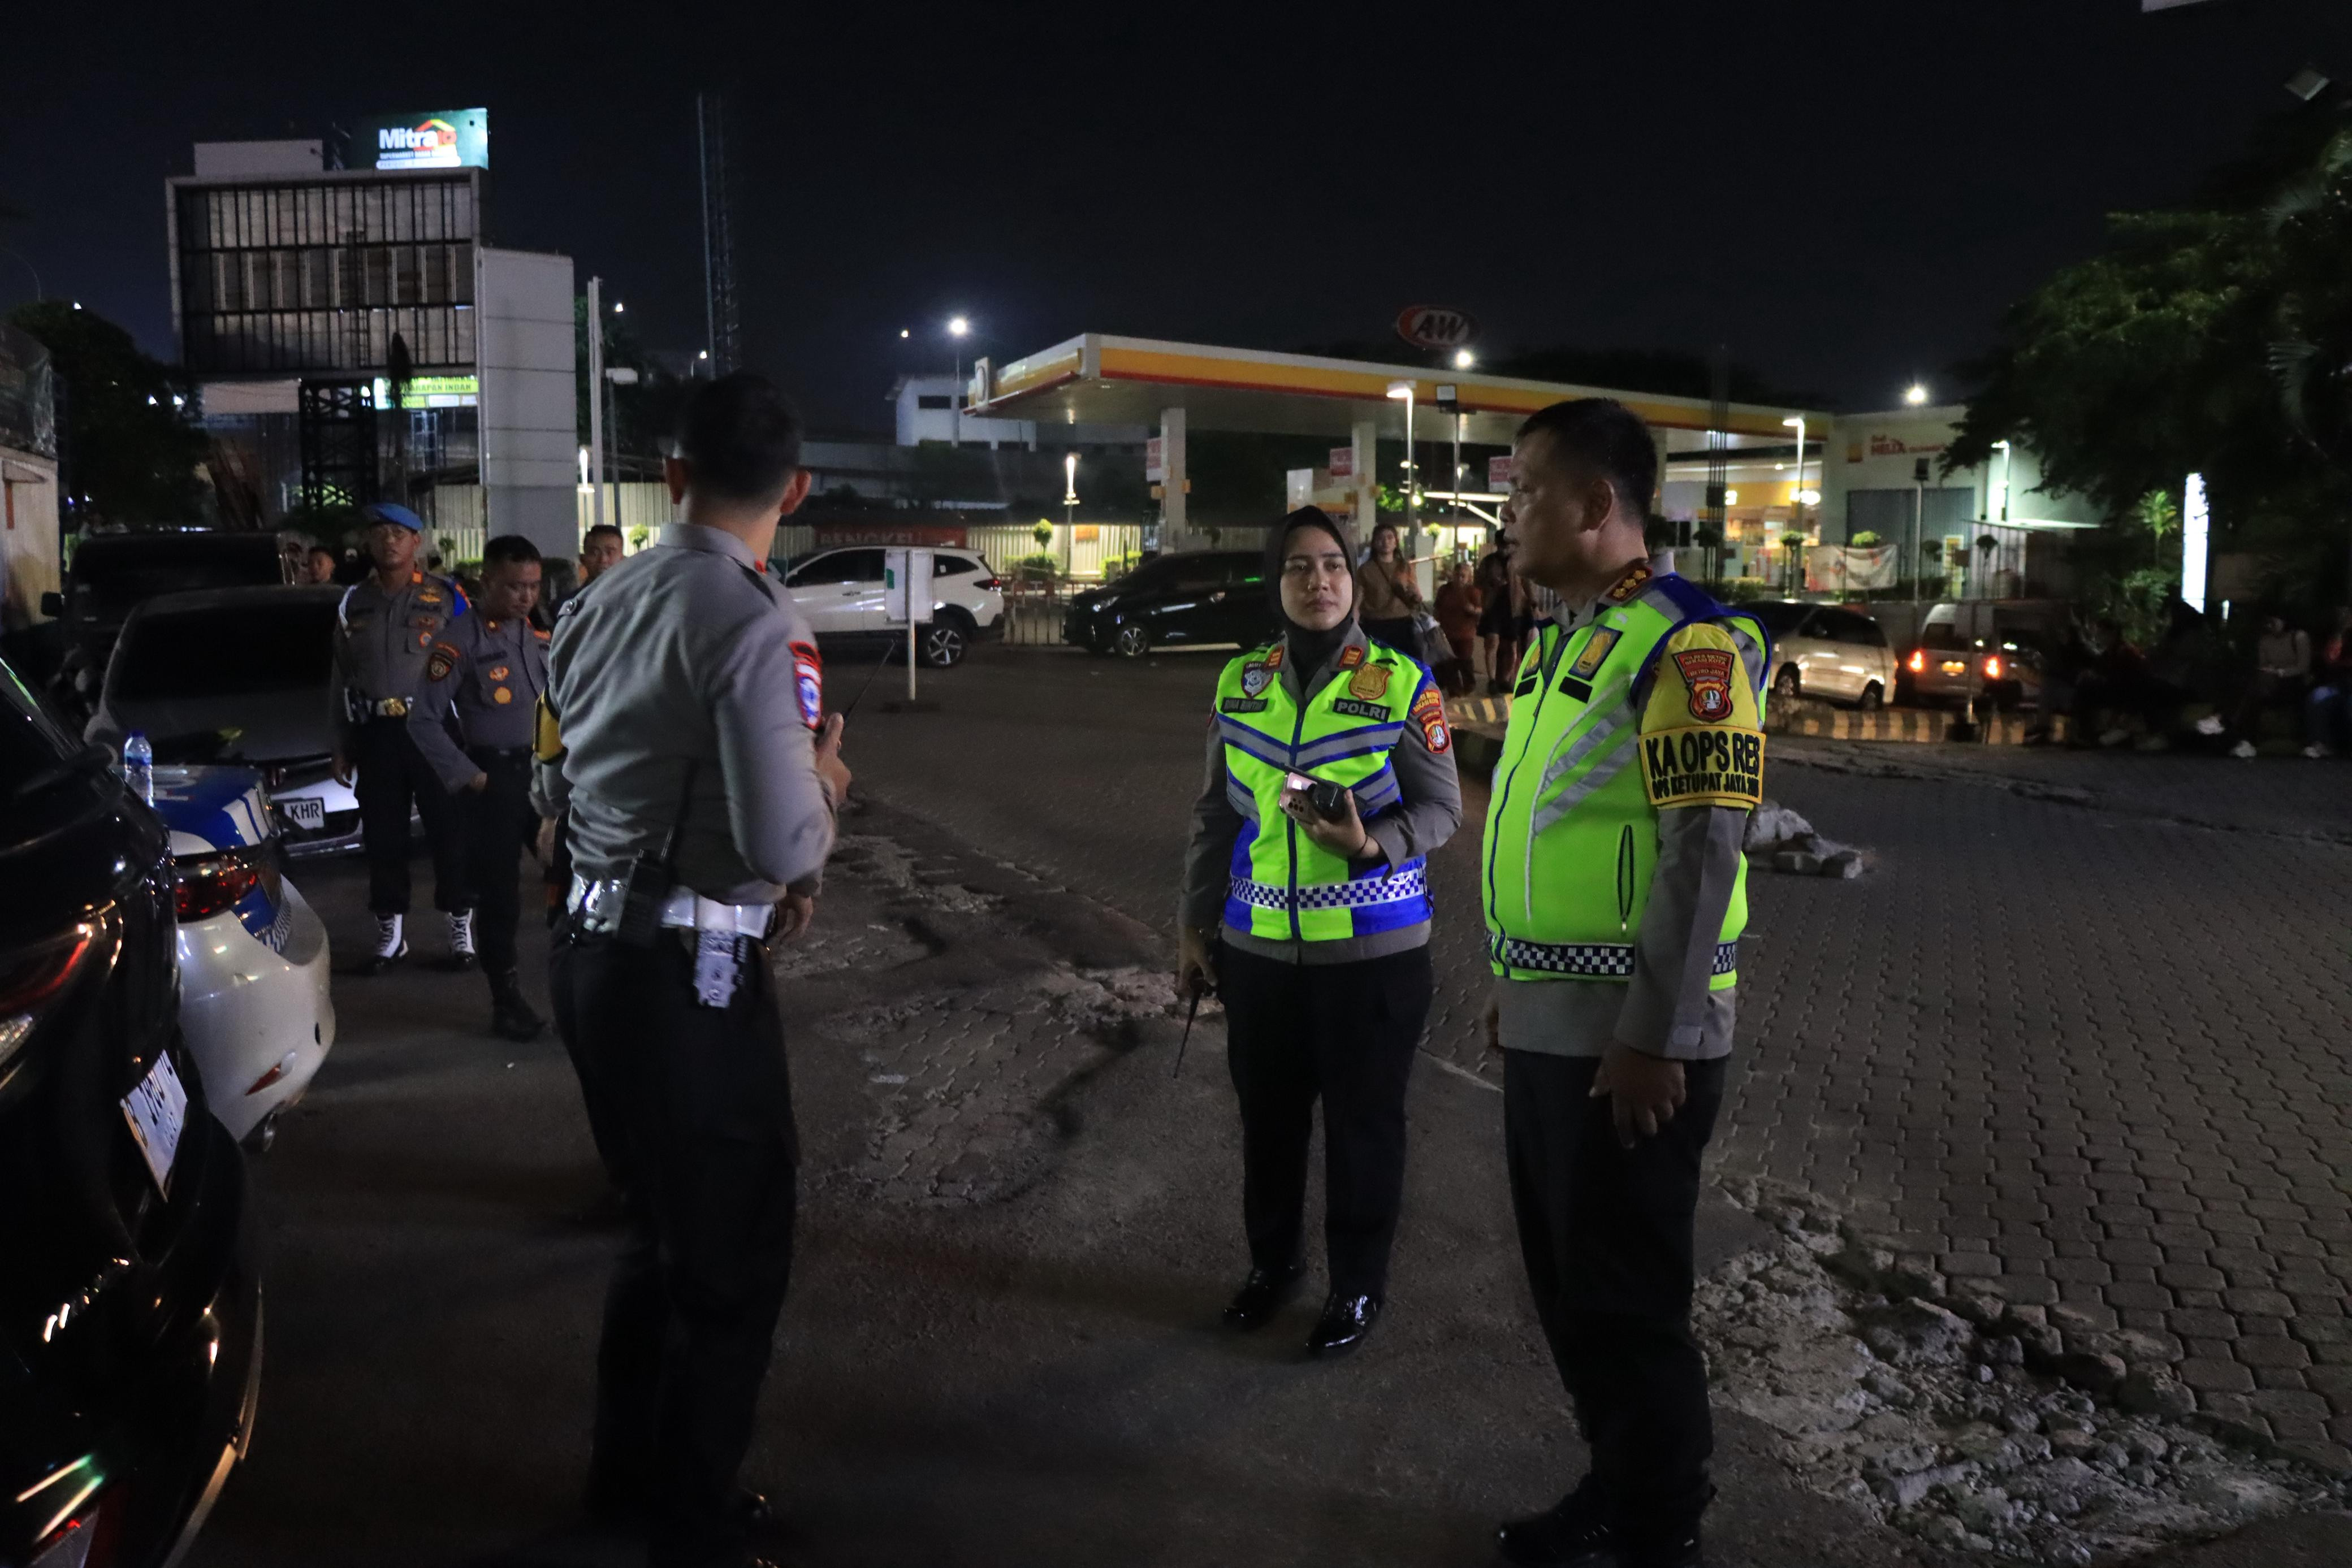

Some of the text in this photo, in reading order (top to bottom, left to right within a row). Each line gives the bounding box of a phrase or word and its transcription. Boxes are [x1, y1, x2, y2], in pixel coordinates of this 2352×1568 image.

[379, 128, 457, 149] Mitra10
[1337, 701, 1387, 720] POLRI
[1645, 730, 1760, 779] KA OPS RES
[1670, 772, 1723, 795] KETUPAT
[1724, 773, 1746, 794] JAYA
[290, 803, 319, 820] KHR
